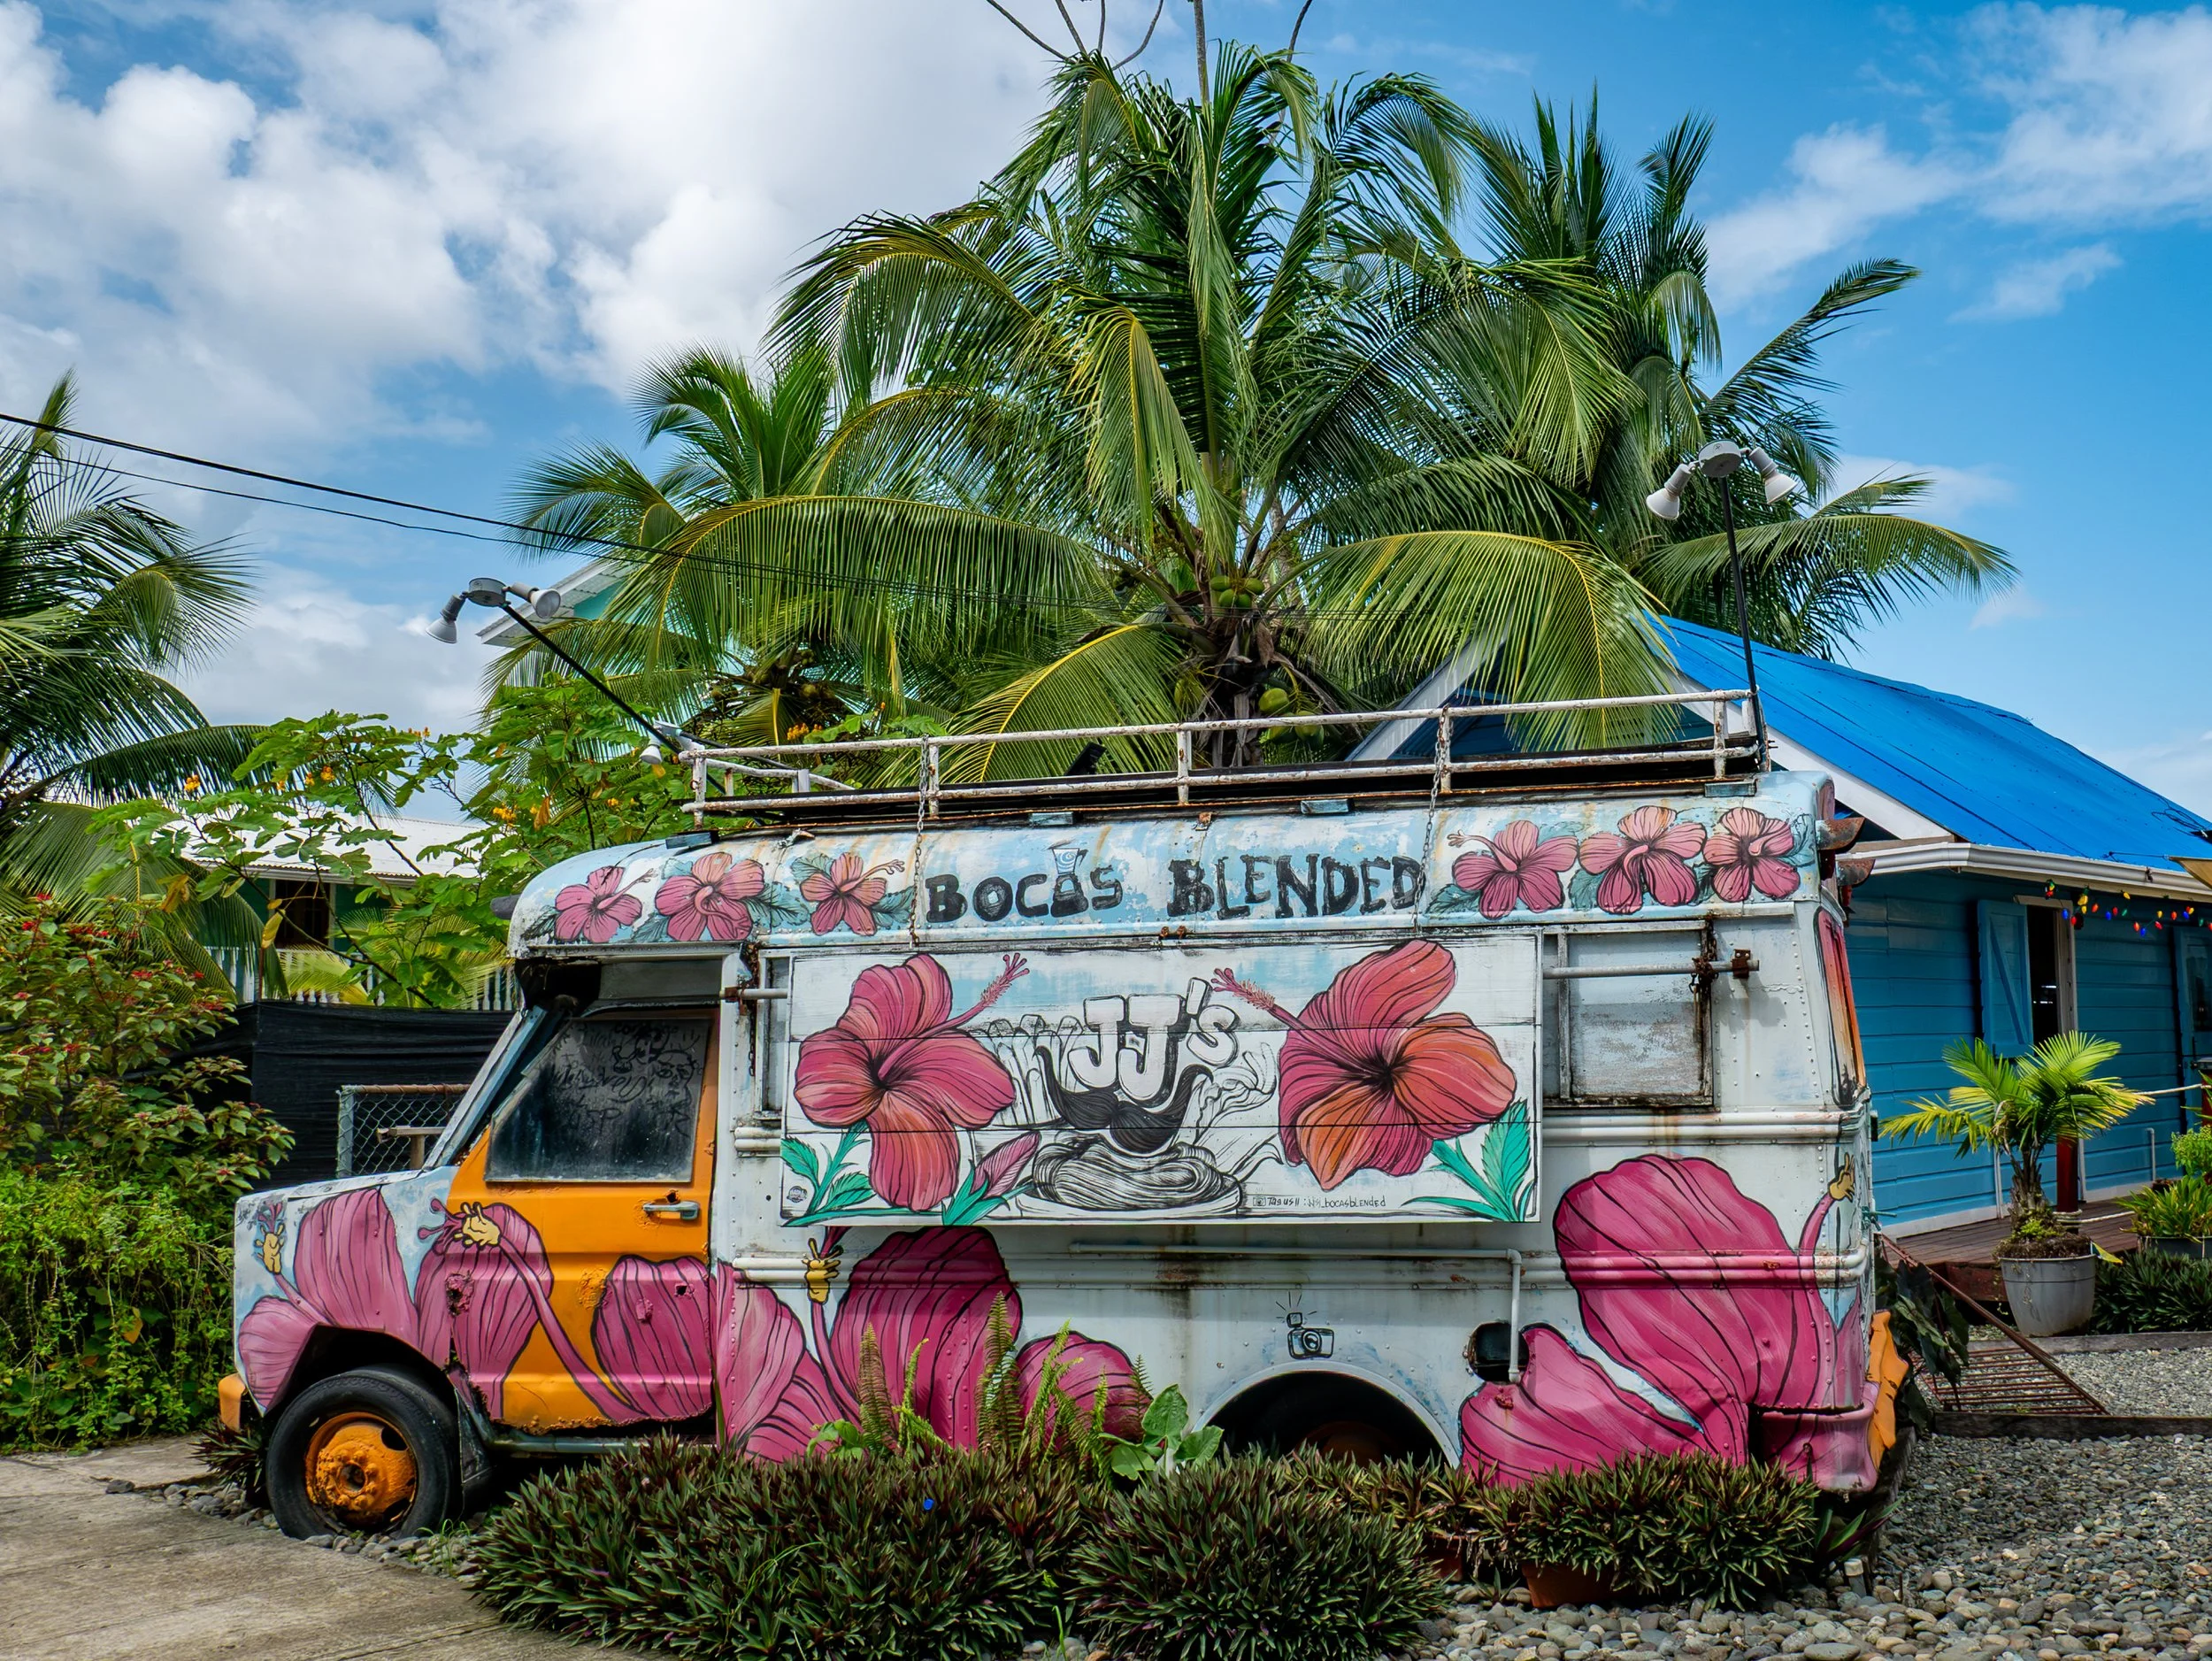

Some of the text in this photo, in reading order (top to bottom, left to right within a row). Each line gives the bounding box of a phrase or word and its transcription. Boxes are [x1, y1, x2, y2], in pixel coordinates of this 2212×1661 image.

[925, 852, 1423, 923] BOCAS BLENDED
[1067, 977, 1240, 1105] JJ's
